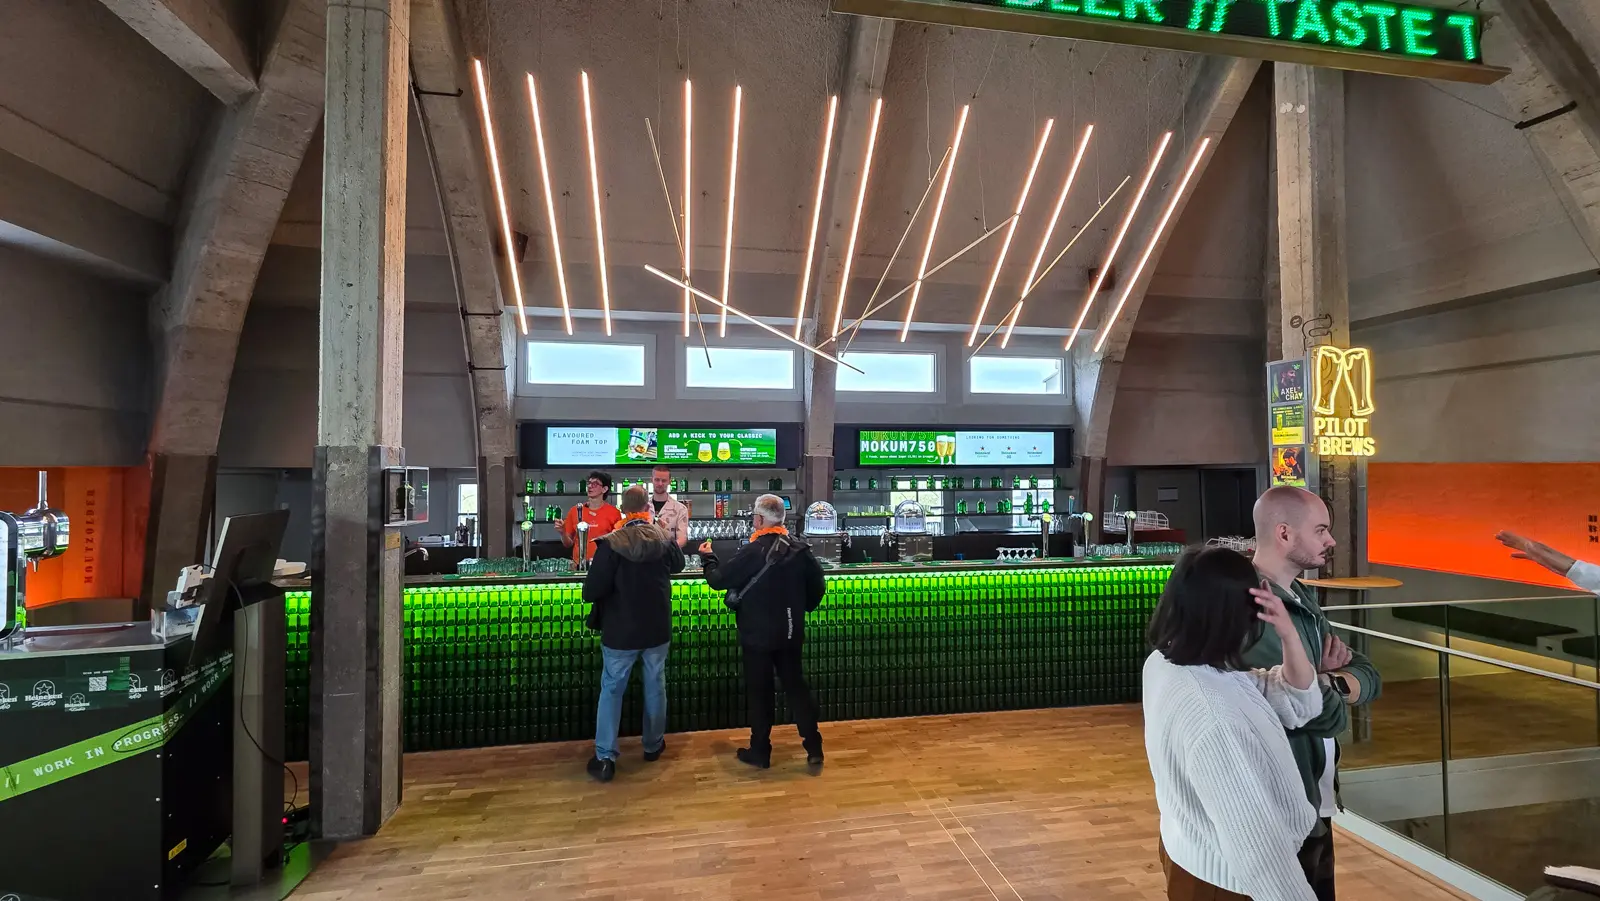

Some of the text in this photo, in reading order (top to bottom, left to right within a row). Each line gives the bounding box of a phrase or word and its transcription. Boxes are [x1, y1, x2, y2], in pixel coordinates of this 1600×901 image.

[1257, 0, 1438, 56] TASTE
[1281, 387, 1299, 395] AXEL
[1313, 417, 1368, 436] PILOT
[860, 440, 936, 452] MOKUM750
[1319, 437, 1375, 456] BREWS
[201, 672, 219, 693] WORK
[25, 692, 63, 702] Heineken
[33, 756, 75, 777] WORK
[84, 746, 105, 760] IN
